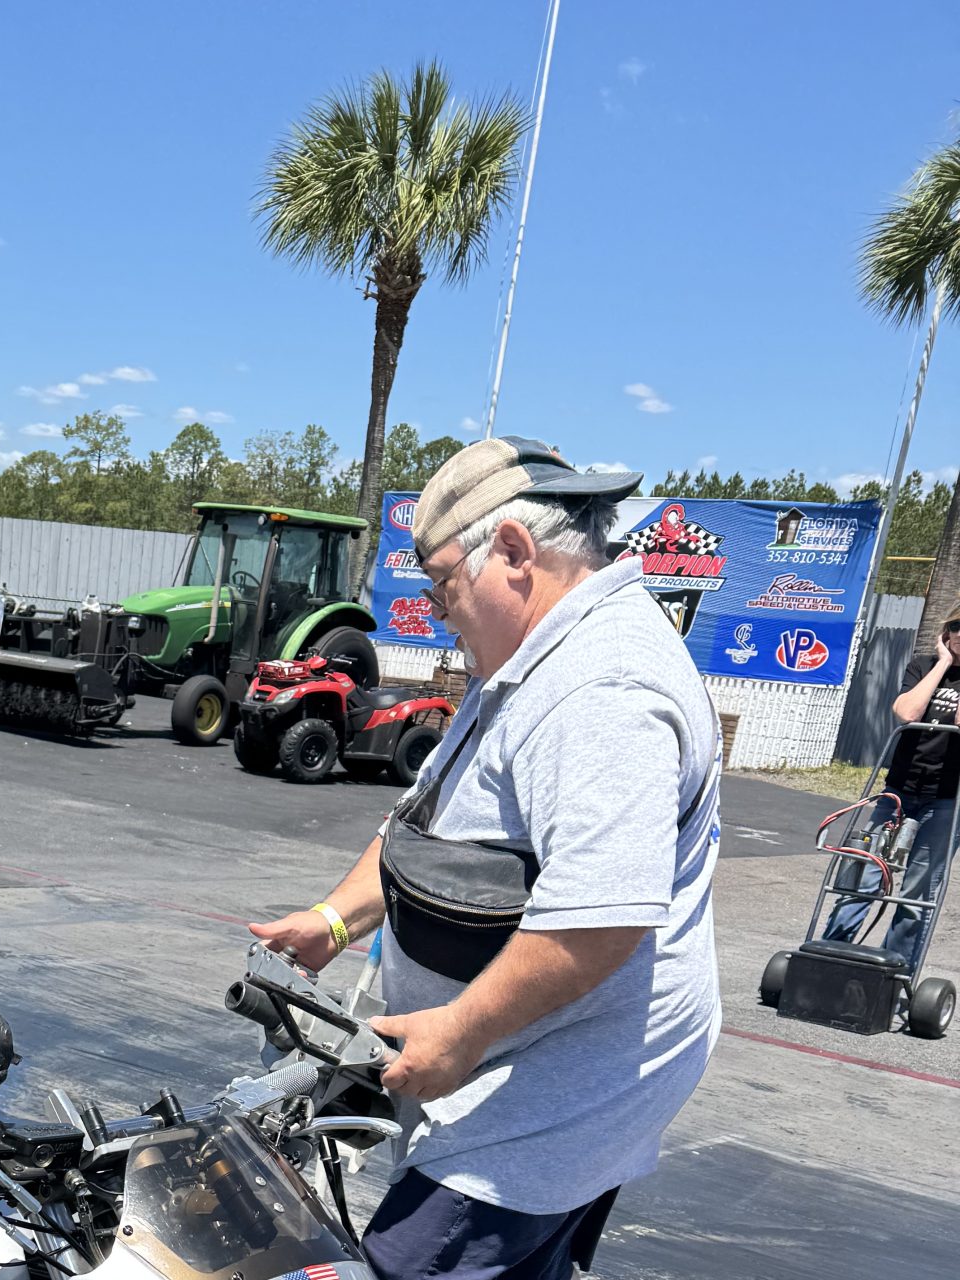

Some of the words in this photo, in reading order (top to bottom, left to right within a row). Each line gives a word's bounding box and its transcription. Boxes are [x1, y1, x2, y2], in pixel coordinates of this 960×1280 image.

[800, 518, 858, 530] FLORIDA
[800, 535, 853, 546] SERVICES
[617, 550, 727, 577] ORPION
[766, 550, 849, 565] 352-810-5341
[659, 578, 720, 588] PRODUCTS
[760, 595, 831, 604] AUTOMOTIVE
[747, 600, 784, 608] SPEED
[796, 603, 844, 612] CUSTOM
[781, 629, 816, 669] VP
